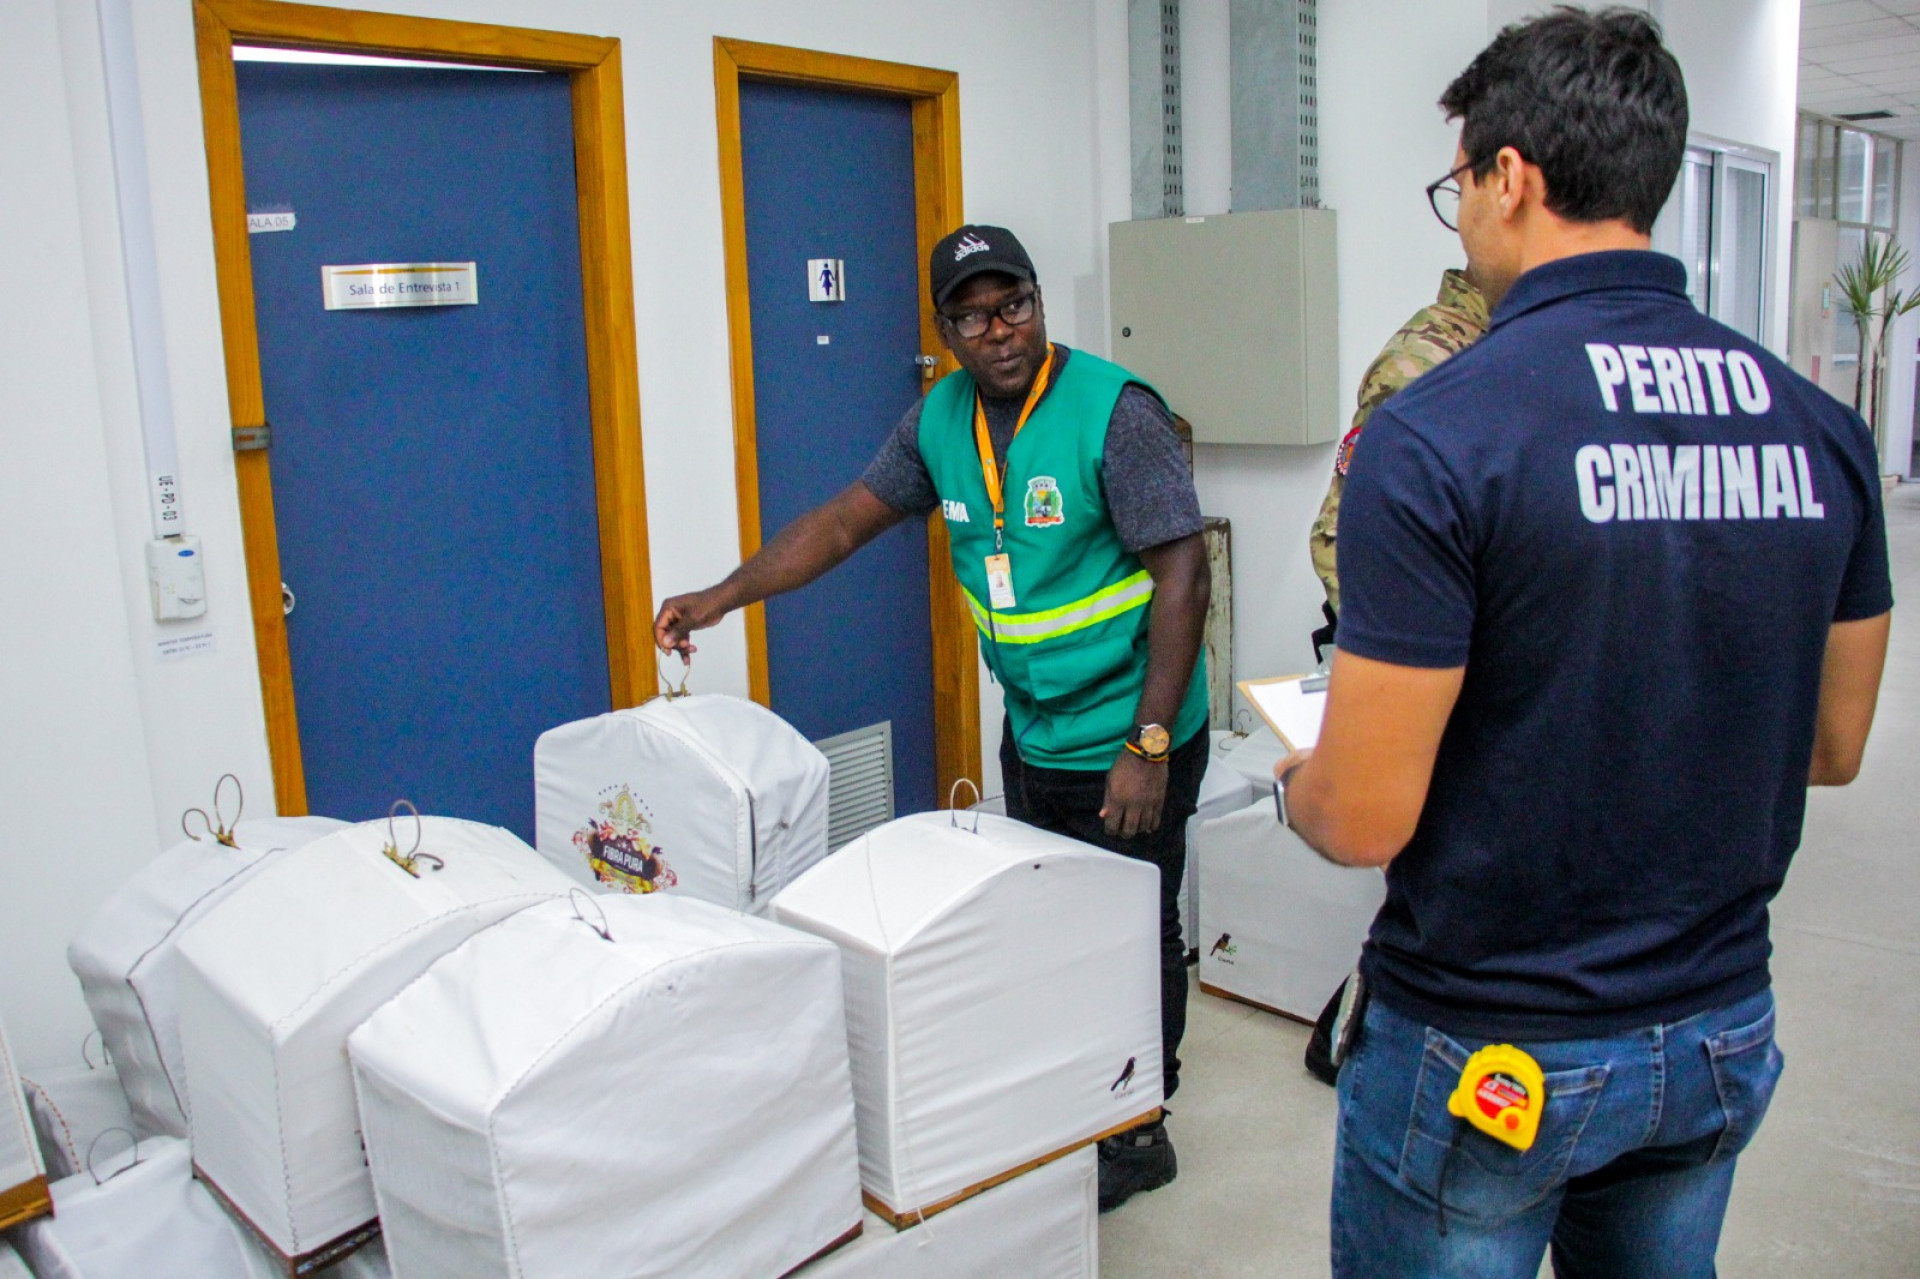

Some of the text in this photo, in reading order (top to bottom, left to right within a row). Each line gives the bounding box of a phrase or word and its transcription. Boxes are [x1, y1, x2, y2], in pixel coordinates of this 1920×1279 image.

[275, 216, 289, 226] 05
[954, 243, 989, 261] adidas
[349, 281, 461, 296] Sala de Entrevista 1
[1585, 343, 1771, 415] PERITO
[1574, 443, 1825, 523] CRIMINAL
[603, 845, 624, 864] FIBRA
[624, 853, 643, 872] PURA
